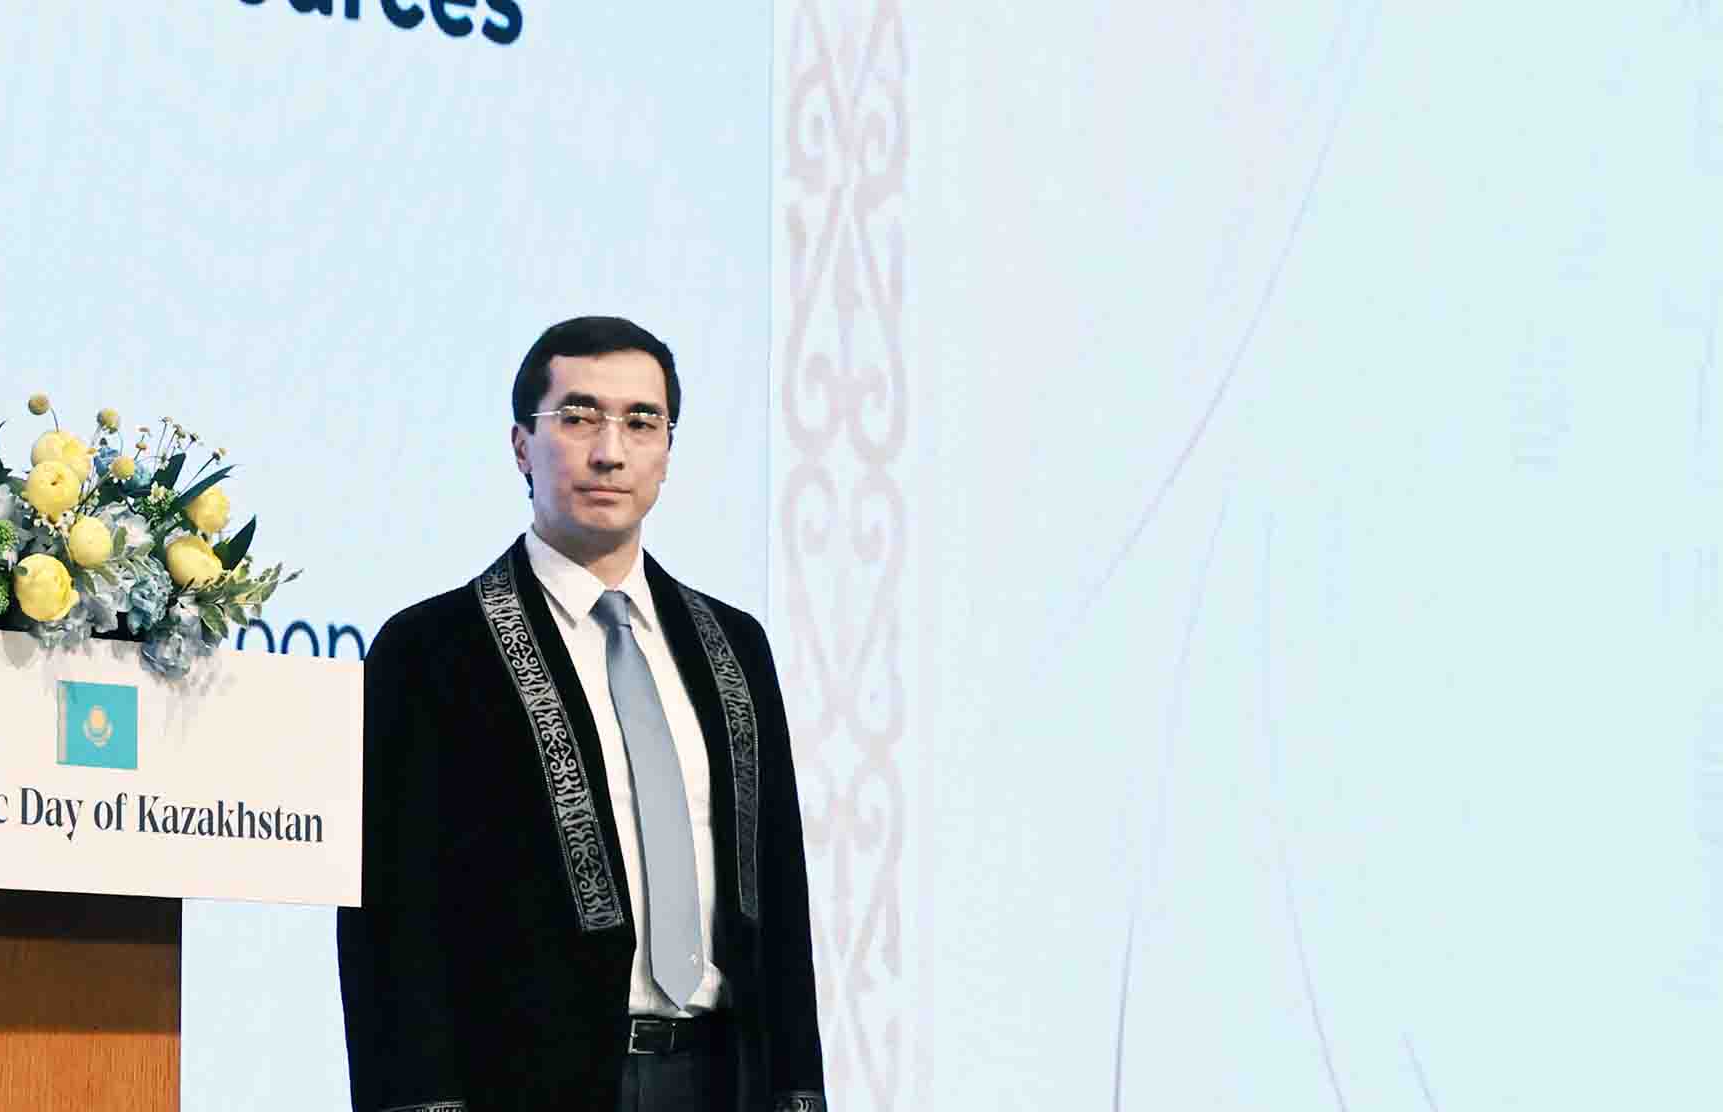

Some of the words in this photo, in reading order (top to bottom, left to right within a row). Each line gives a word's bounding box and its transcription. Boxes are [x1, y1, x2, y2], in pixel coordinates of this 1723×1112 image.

[20, 786, 81, 841] Day
[93, 792, 129, 831] of
[138, 795, 324, 843] Kazakhstan
